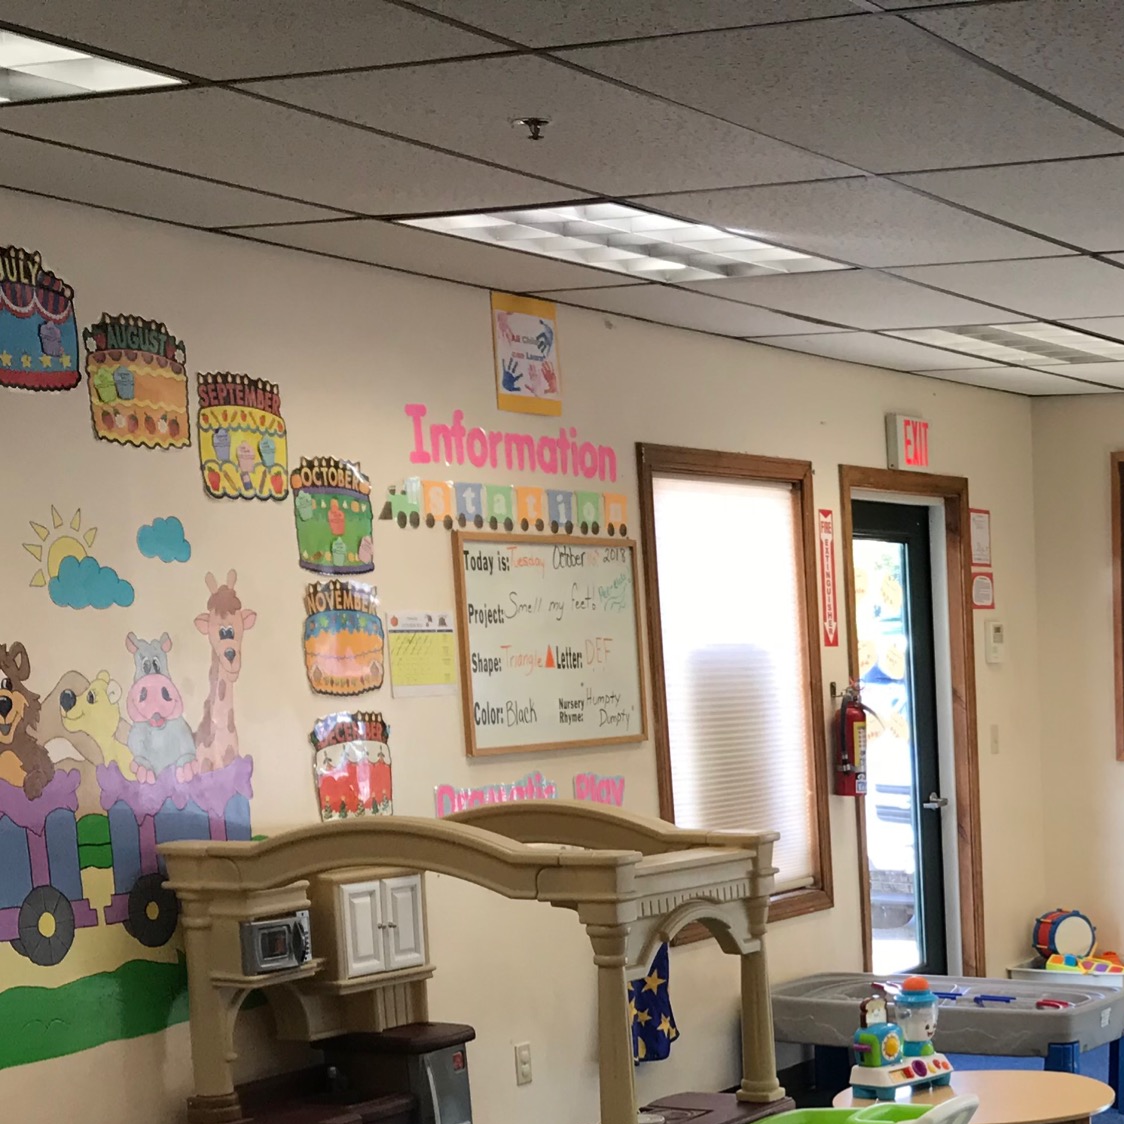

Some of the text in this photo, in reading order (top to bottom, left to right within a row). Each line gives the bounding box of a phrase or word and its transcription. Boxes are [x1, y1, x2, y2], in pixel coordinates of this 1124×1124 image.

[107, 323, 167, 357] AUGUST
[199, 382, 280, 417] SEPTEMBER
[404, 403, 617, 483] Information
[903, 419, 929, 467] EXIT
[301, 466, 359, 492] OCTOBER
[428, 485, 622, 524] Station
[820, 521, 832, 534] FIRE
[464, 550, 494, 575] Today
[497, 551, 510, 571] is:
[553, 545, 586, 569] October
[603, 547, 625, 563] 2018
[305, 589, 378, 616] NOVEMBER
[824, 538, 834, 636] EXTINGUISHER
[468, 603, 505, 629] Project:
[504, 591, 542, 619] Smell
[549, 599, 565, 621] my
[471, 652, 502, 677] Shape:
[500, 645, 543, 676] Triangle
[556, 645, 583, 669] Letter:
[474, 697, 537, 727] Color: Black
[559, 688, 621, 711] Nursery Humpty
[560, 708, 631, 731] Rhyme: Dumpty
[575, 773, 625, 808] Play
